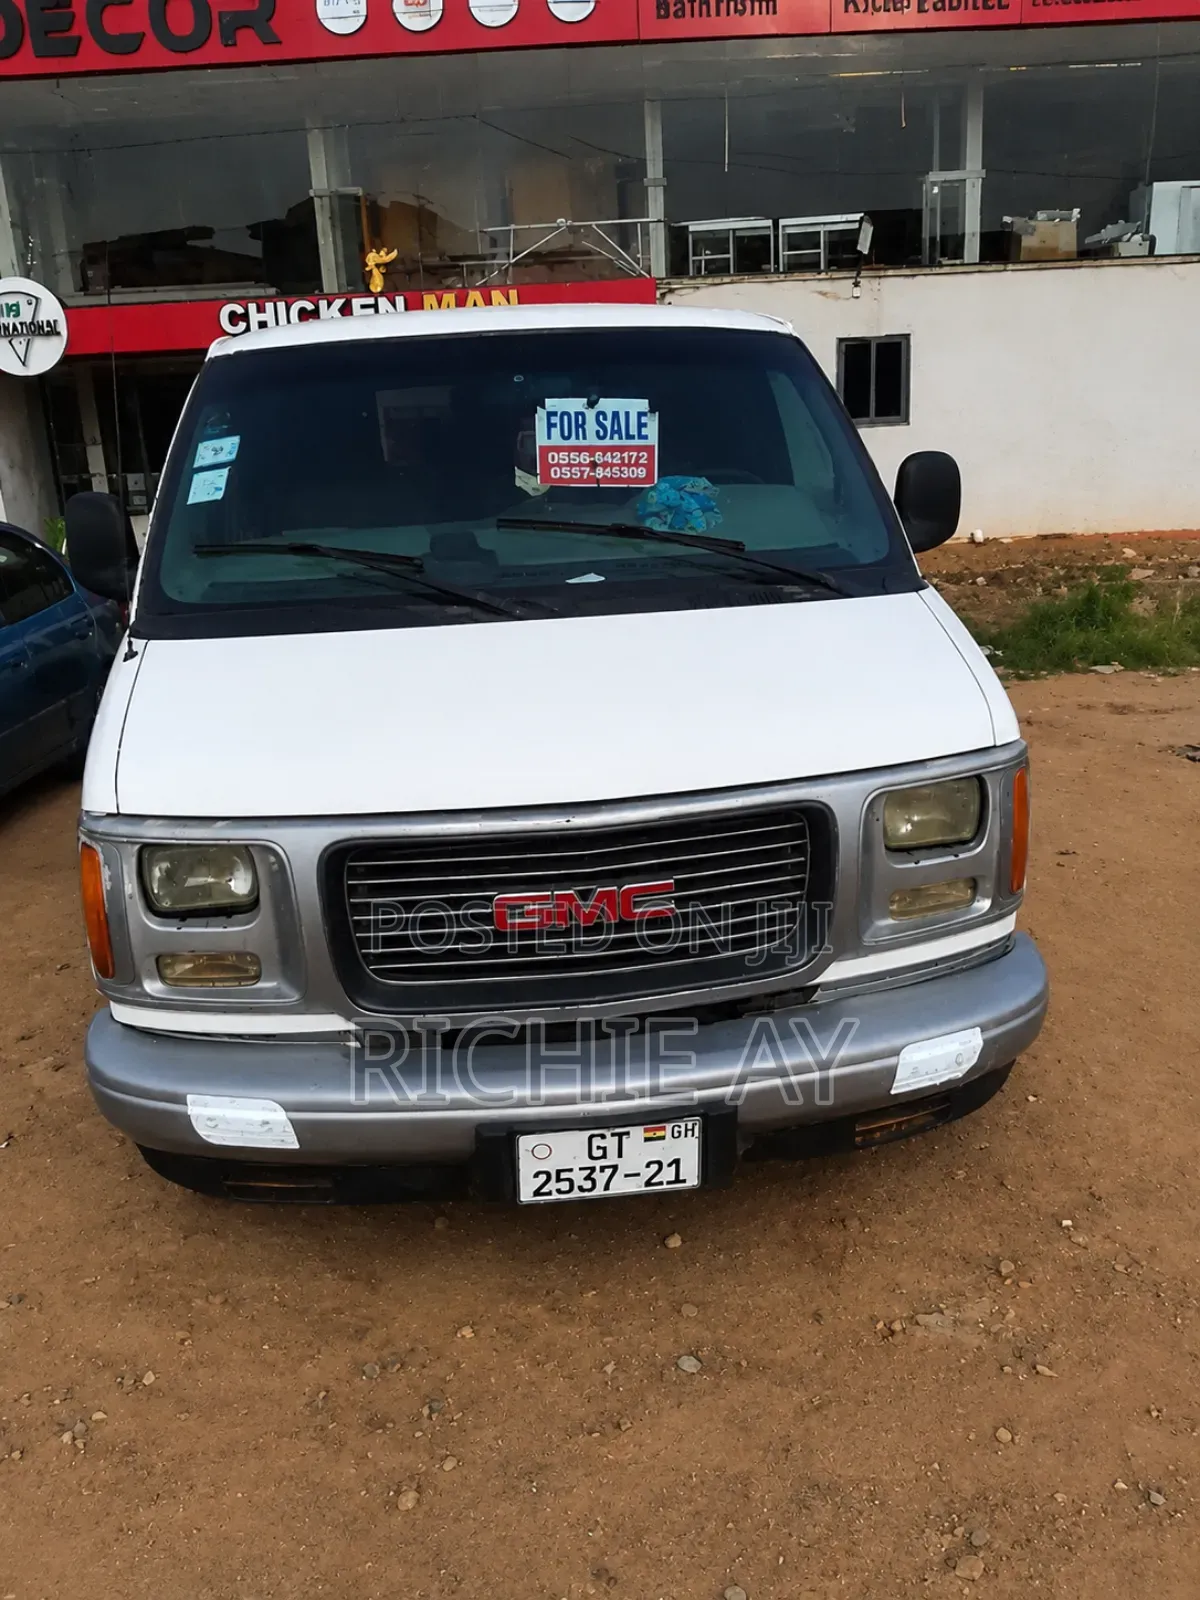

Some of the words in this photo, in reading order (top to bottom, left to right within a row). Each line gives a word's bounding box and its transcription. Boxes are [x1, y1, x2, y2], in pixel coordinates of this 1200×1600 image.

[219, 295, 405, 335] CHICKEN
[422, 289, 518, 311] MAN
[0, 319, 61, 337] NATIONAL
[546, 410, 587, 441] FOR
[595, 410, 649, 441] SALE
[547, 451, 648, 465] 0556-642172
[493, 879, 676, 932] GMC
[587, 1130, 630, 1160] GT
[671, 1123, 696, 1139] GH
[532, 1158, 687, 1197] 2537-21
